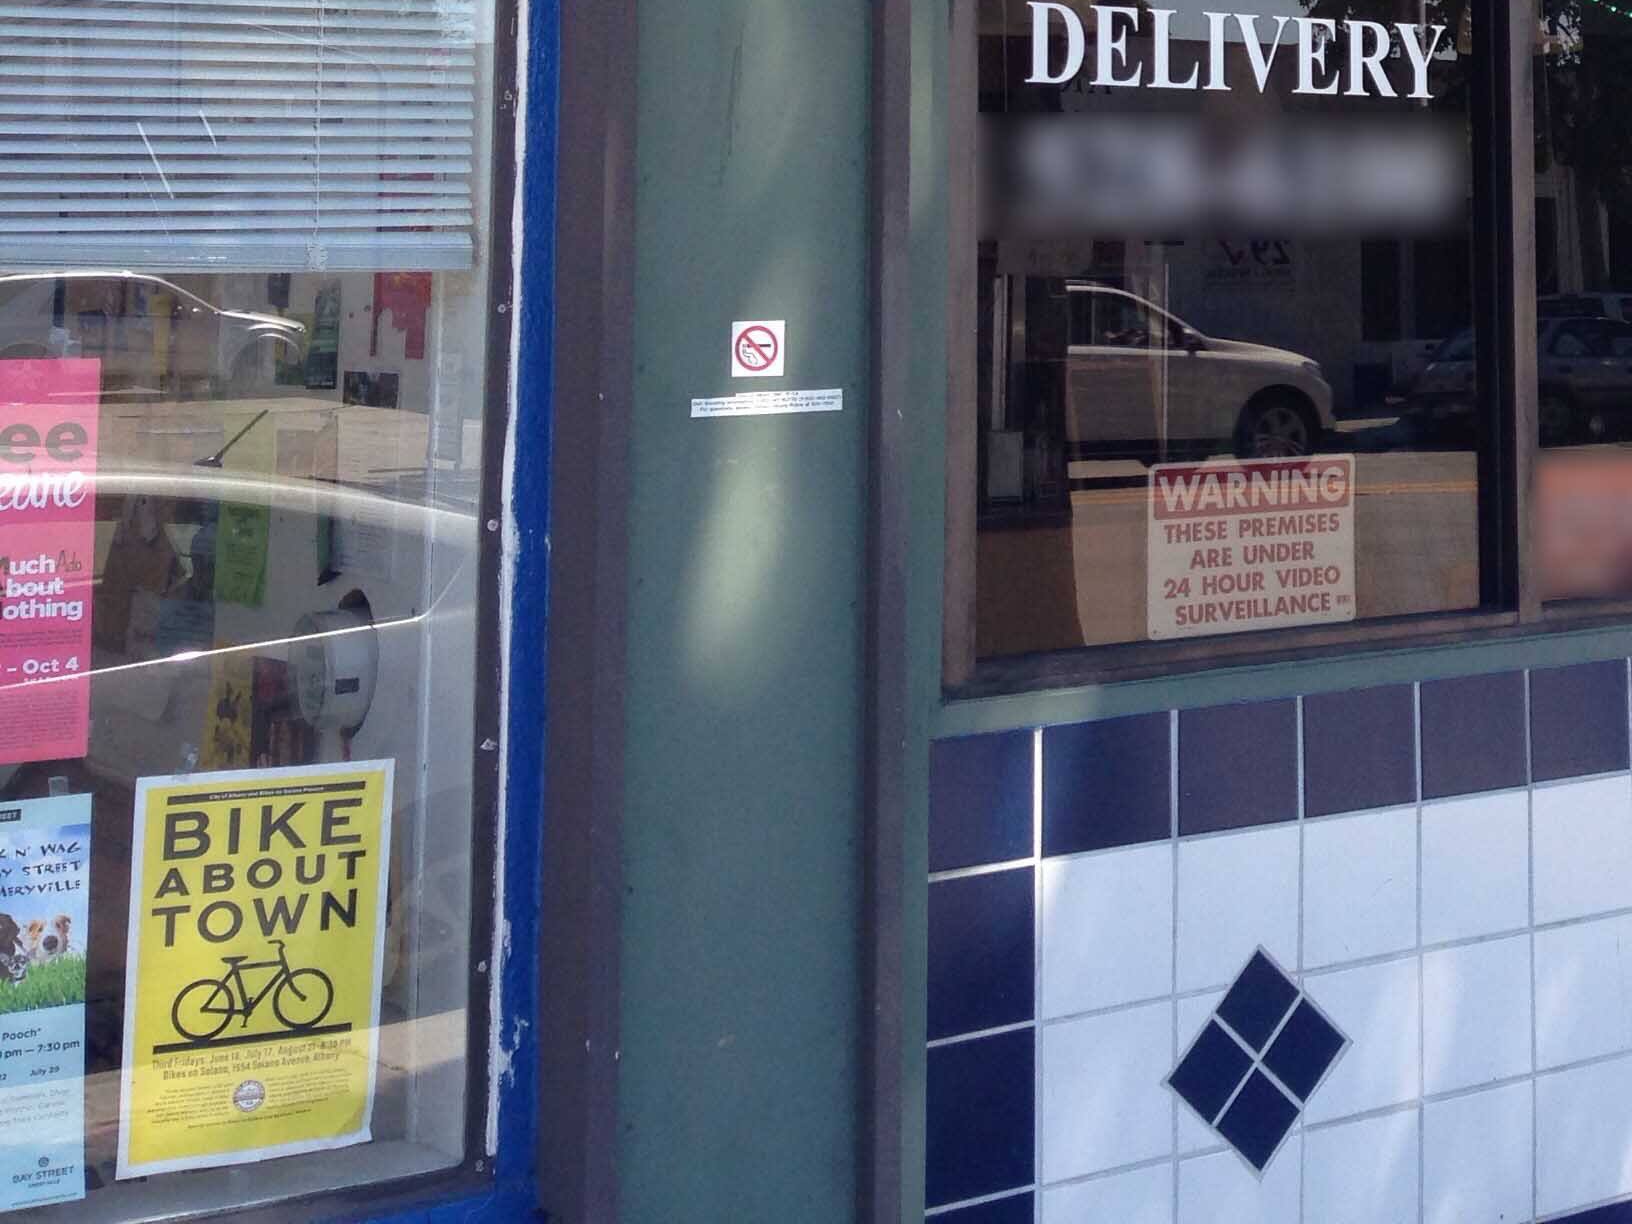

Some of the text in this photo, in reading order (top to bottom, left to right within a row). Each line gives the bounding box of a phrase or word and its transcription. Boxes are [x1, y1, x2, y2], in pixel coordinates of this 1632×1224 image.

[1024, 0, 1447, 100] DELIVERY
[1159, 466, 1346, 512] WARNING
[1164, 513, 1340, 544] THESE PREMISES
[1190, 541, 1315, 569] ARE UNDER
[1164, 565, 1341, 600] 24 HOUR VIDEO
[2, 598, 84, 621] othing
[1175, 592, 1331, 626] SURVEILLANCE
[22, 659, 60, 675] Oct
[65, 656, 80, 671] 4
[163, 797, 363, 861] BIKE
[40, 842, 81, 857] WAG
[154, 850, 367, 899] ABOUT
[152, 888, 358, 948] TOWN
[62, 1039, 81, 1051] pm
